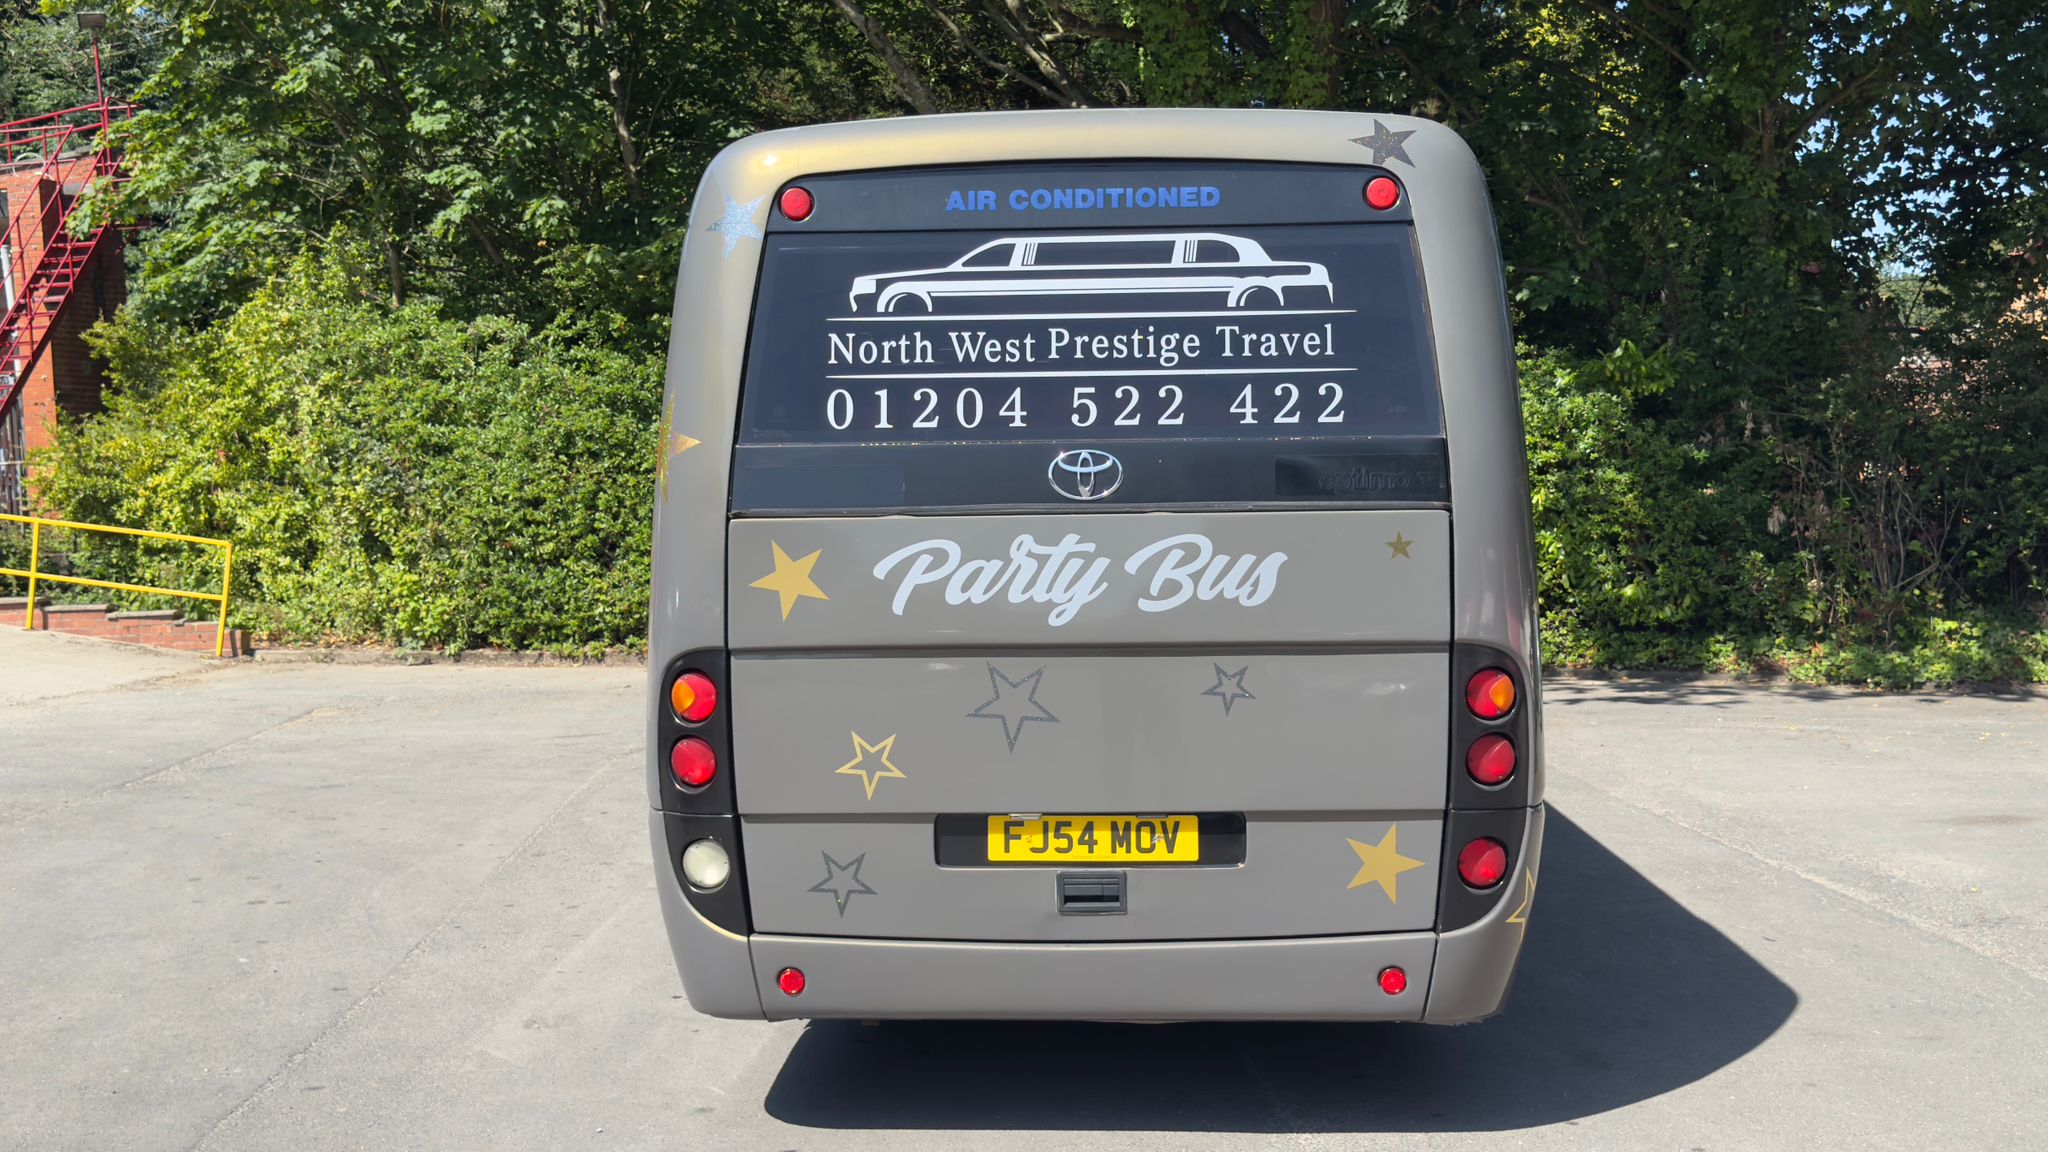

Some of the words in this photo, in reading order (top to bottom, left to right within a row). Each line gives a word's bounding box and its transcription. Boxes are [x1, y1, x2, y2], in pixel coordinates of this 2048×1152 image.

[945, 190, 998, 213] AIR
[1008, 186, 1222, 212] CONDITIONED
[827, 331, 935, 365] North
[947, 331, 1036, 363] West
[1047, 325, 1201, 368] Prestige
[1215, 323, 1335, 357] Travel
[825, 386, 1028, 430] 01204
[1070, 385, 1185, 427] 522
[1229, 382, 1345, 424] 422
[872, 533, 1112, 627] Party
[1124, 533, 1289, 613] Bus
[1003, 820, 1098, 854] FJ54
[1110, 820, 1181, 854] MOV
